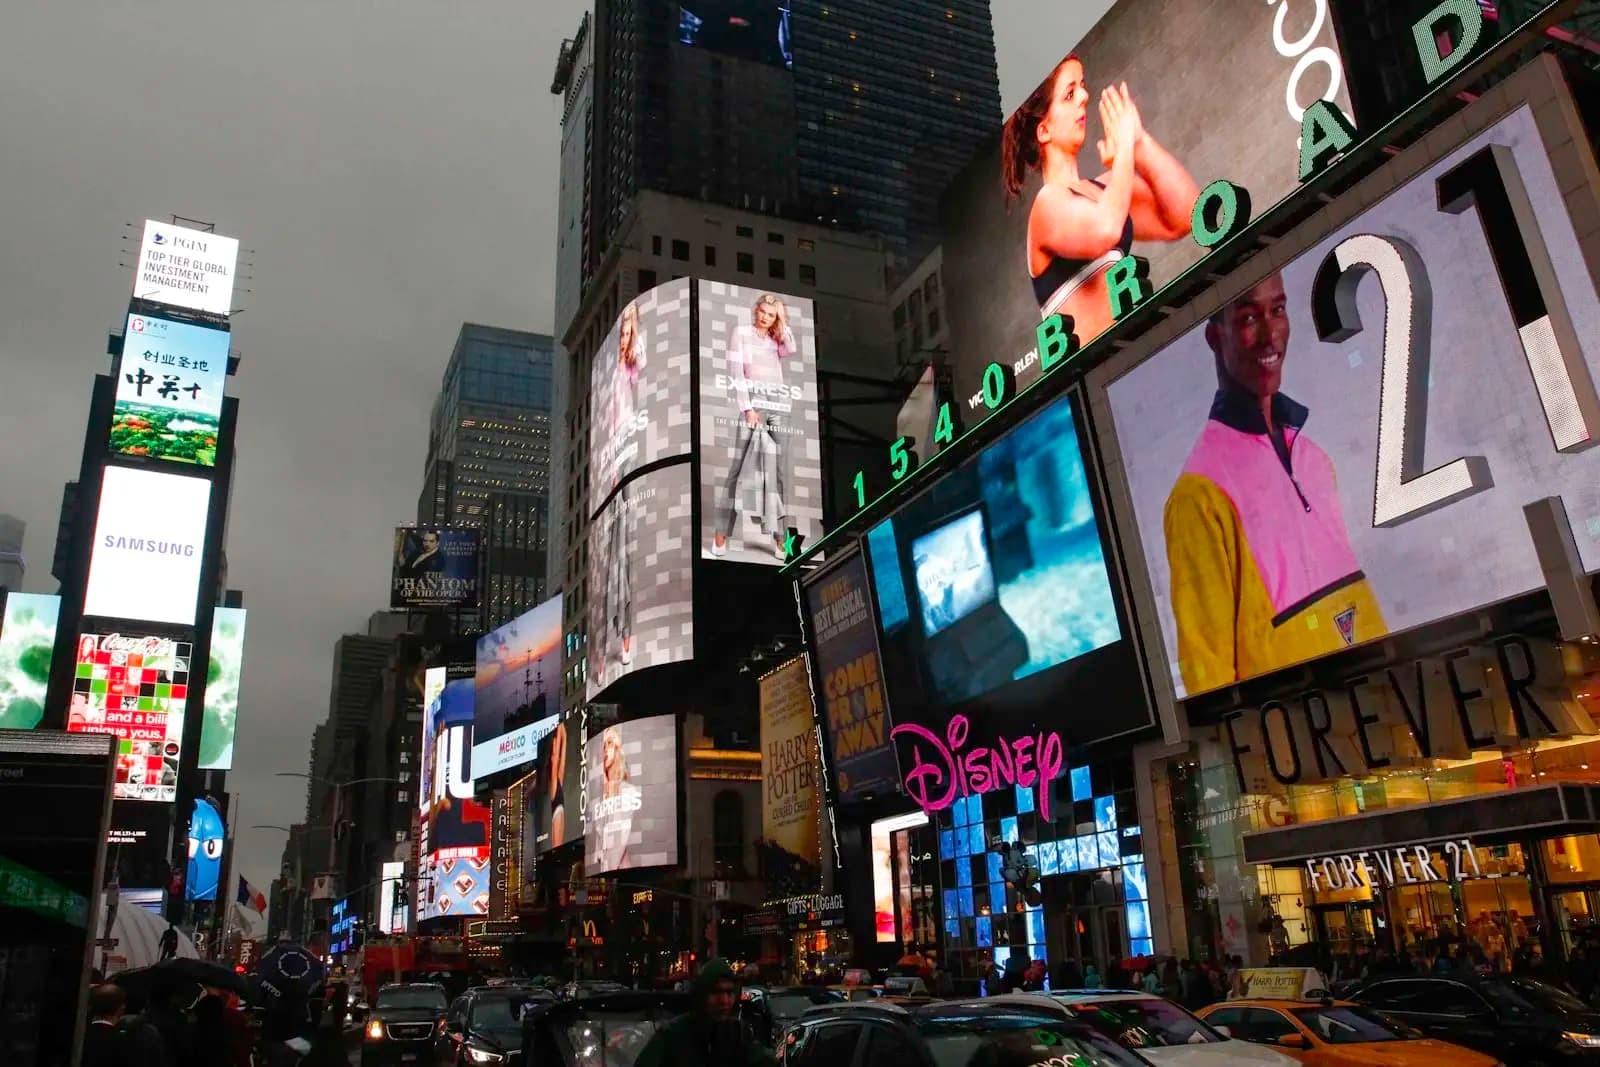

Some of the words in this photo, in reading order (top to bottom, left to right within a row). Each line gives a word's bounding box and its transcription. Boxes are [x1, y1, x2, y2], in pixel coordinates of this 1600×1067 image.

[173, 236, 207, 253] PGIM
[145, 261, 205, 281] INVESTMENT
[147, 250, 166, 261] TOP
[169, 254, 190, 267] TIER
[192, 260, 229, 276] GLOBAL
[143, 272, 209, 294] MANAGEMENT
[1312, 144, 1595, 528] 21
[143, 350, 209, 372] 创业圣地
[1014, 347, 1038, 377] RLEN
[715, 374, 802, 400] EXPRESS
[853, 362, 1006, 508] 1540
[104, 535, 195, 557] SAMSUNG
[393, 577, 476, 591] PHANTOM
[400, 589, 414, 598] OF
[416, 589, 434, 598] THE
[436, 590, 469, 598] OPERA
[831, 587, 866, 625] MUSICAL
[825, 652, 878, 699] COME
[107, 712, 132, 723] and
[135, 715, 142, 723] a
[1223, 634, 1560, 794] FOREVER
[130, 728, 163, 740] yous.
[836, 710, 885, 760] AWAY
[768, 728, 811, 771] HARRY
[766, 761, 814, 804] POTTER
[594, 791, 642, 820] EXPRESS
[497, 798, 507, 890] PALACE
[1307, 846, 1439, 892] FOREVER
[1445, 839, 1481, 882] 21
[787, 900, 807, 915] GIFTS
[811, 894, 845, 911] LUGGAGE
[1253, 975, 1273, 986] HARRY
[1275, 975, 1299, 986] POTTER
